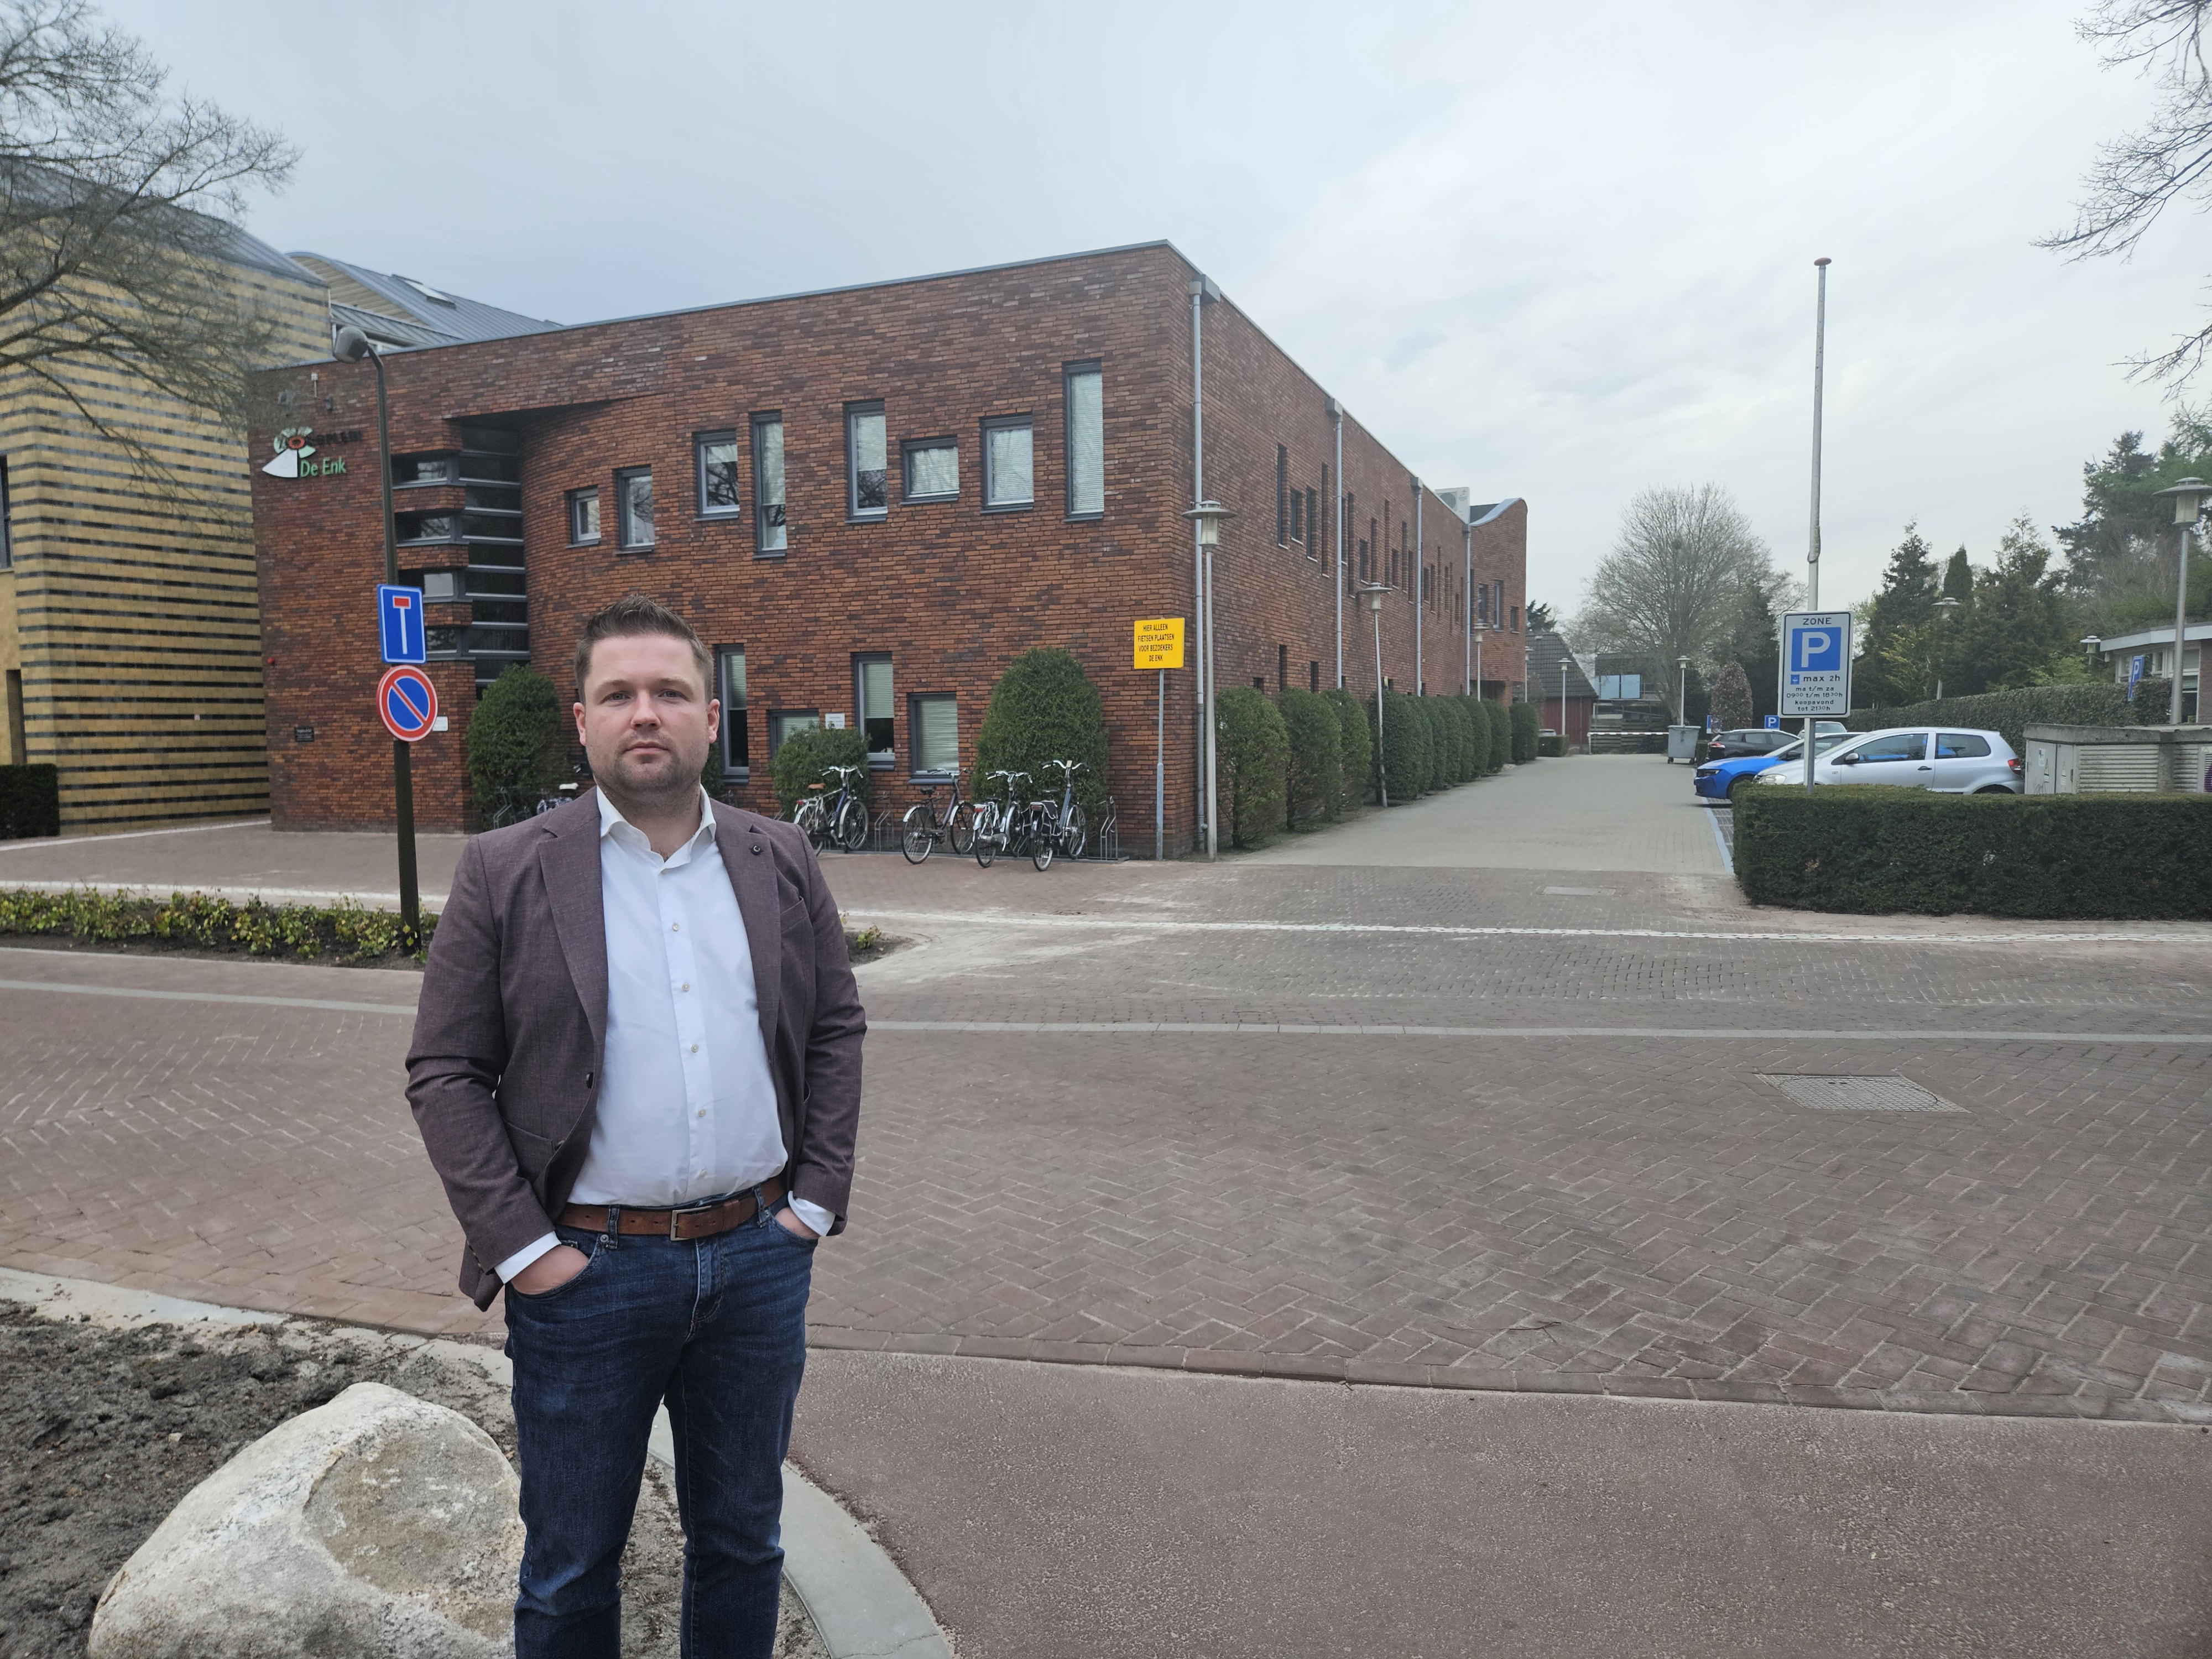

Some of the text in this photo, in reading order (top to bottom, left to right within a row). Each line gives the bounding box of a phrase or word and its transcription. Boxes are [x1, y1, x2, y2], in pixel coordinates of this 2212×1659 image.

[300, 456, 347, 477] De Enk
[1801, 632, 1830, 667] P
[2132, 661, 2140, 682] P
[1768, 717, 1777, 727] P
